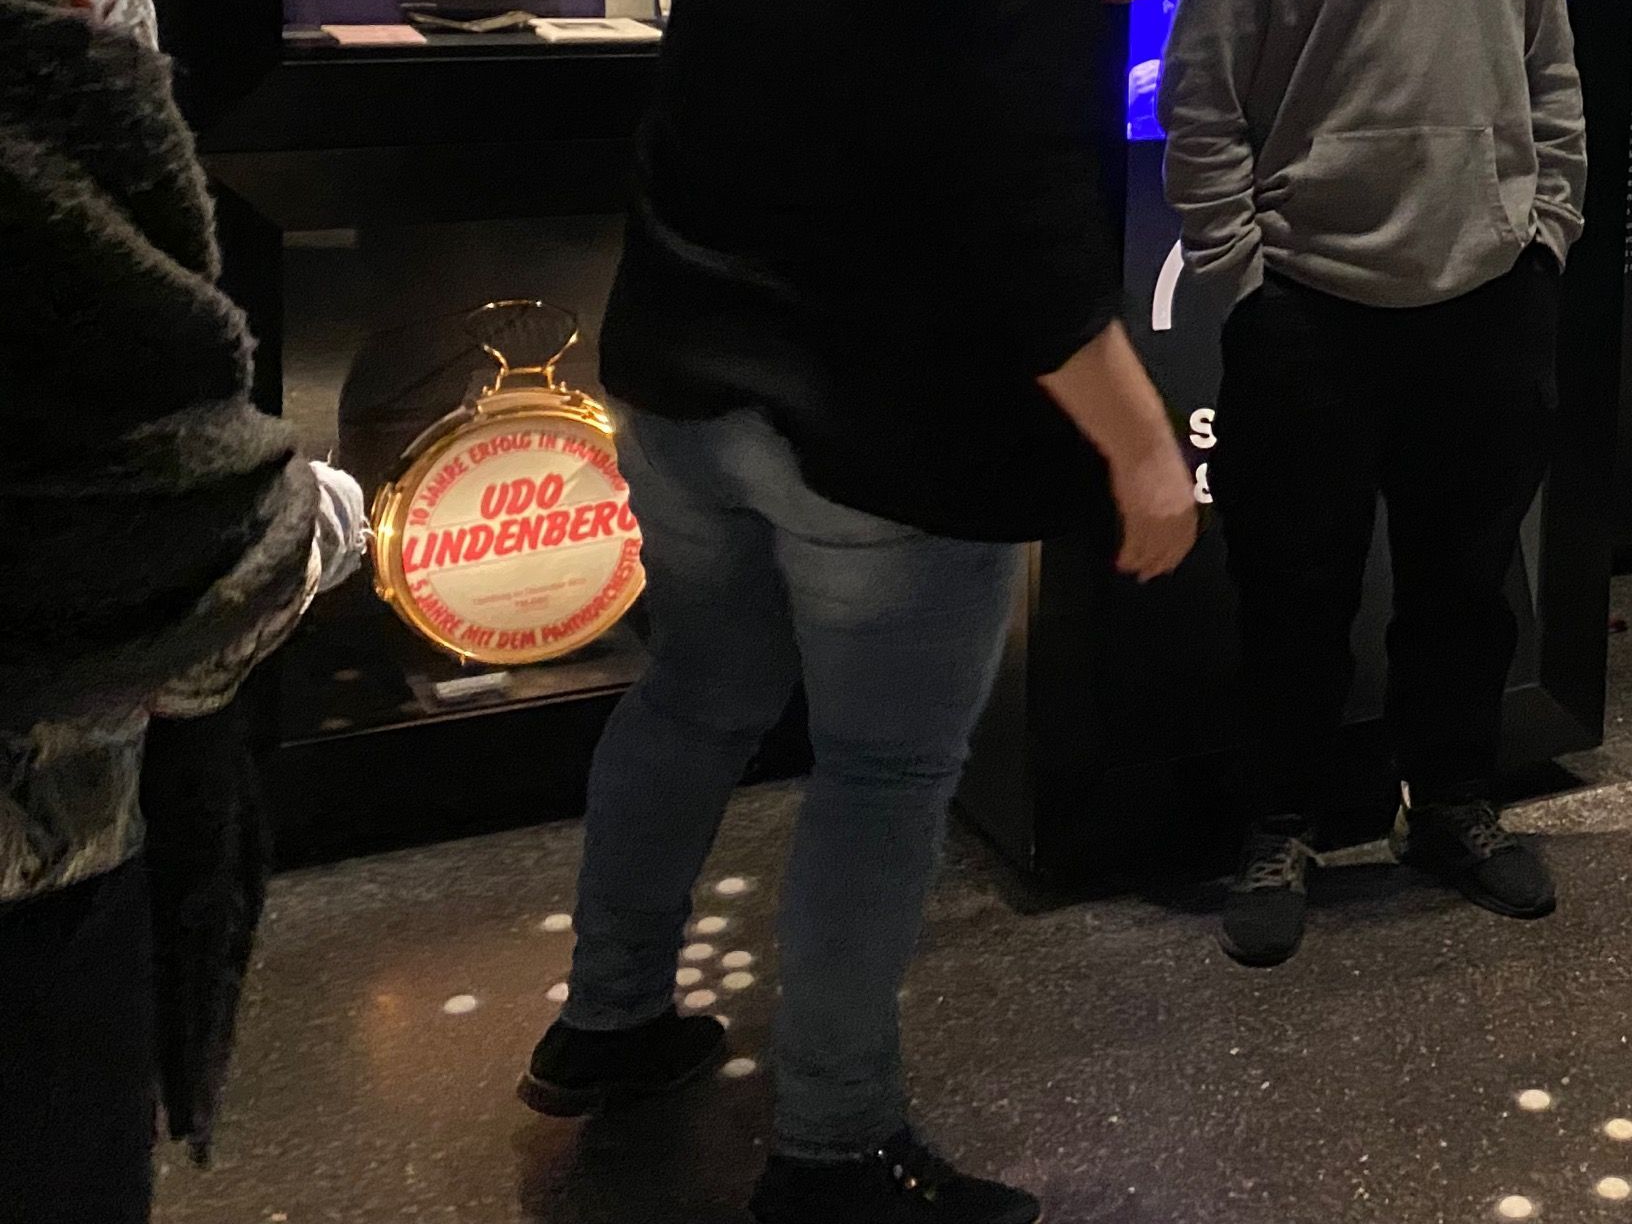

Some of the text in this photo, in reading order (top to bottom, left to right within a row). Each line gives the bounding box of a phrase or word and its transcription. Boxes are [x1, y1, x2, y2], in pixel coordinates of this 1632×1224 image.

[421, 457, 469, 509] JAHRE
[469, 432, 531, 465] ERFOLG
[538, 432, 558, 450] IN
[480, 472, 565, 520] UDO
[416, 593, 463, 638] JAHRE
[461, 625, 492, 648] MIT
[496, 628, 537, 649] DEM
